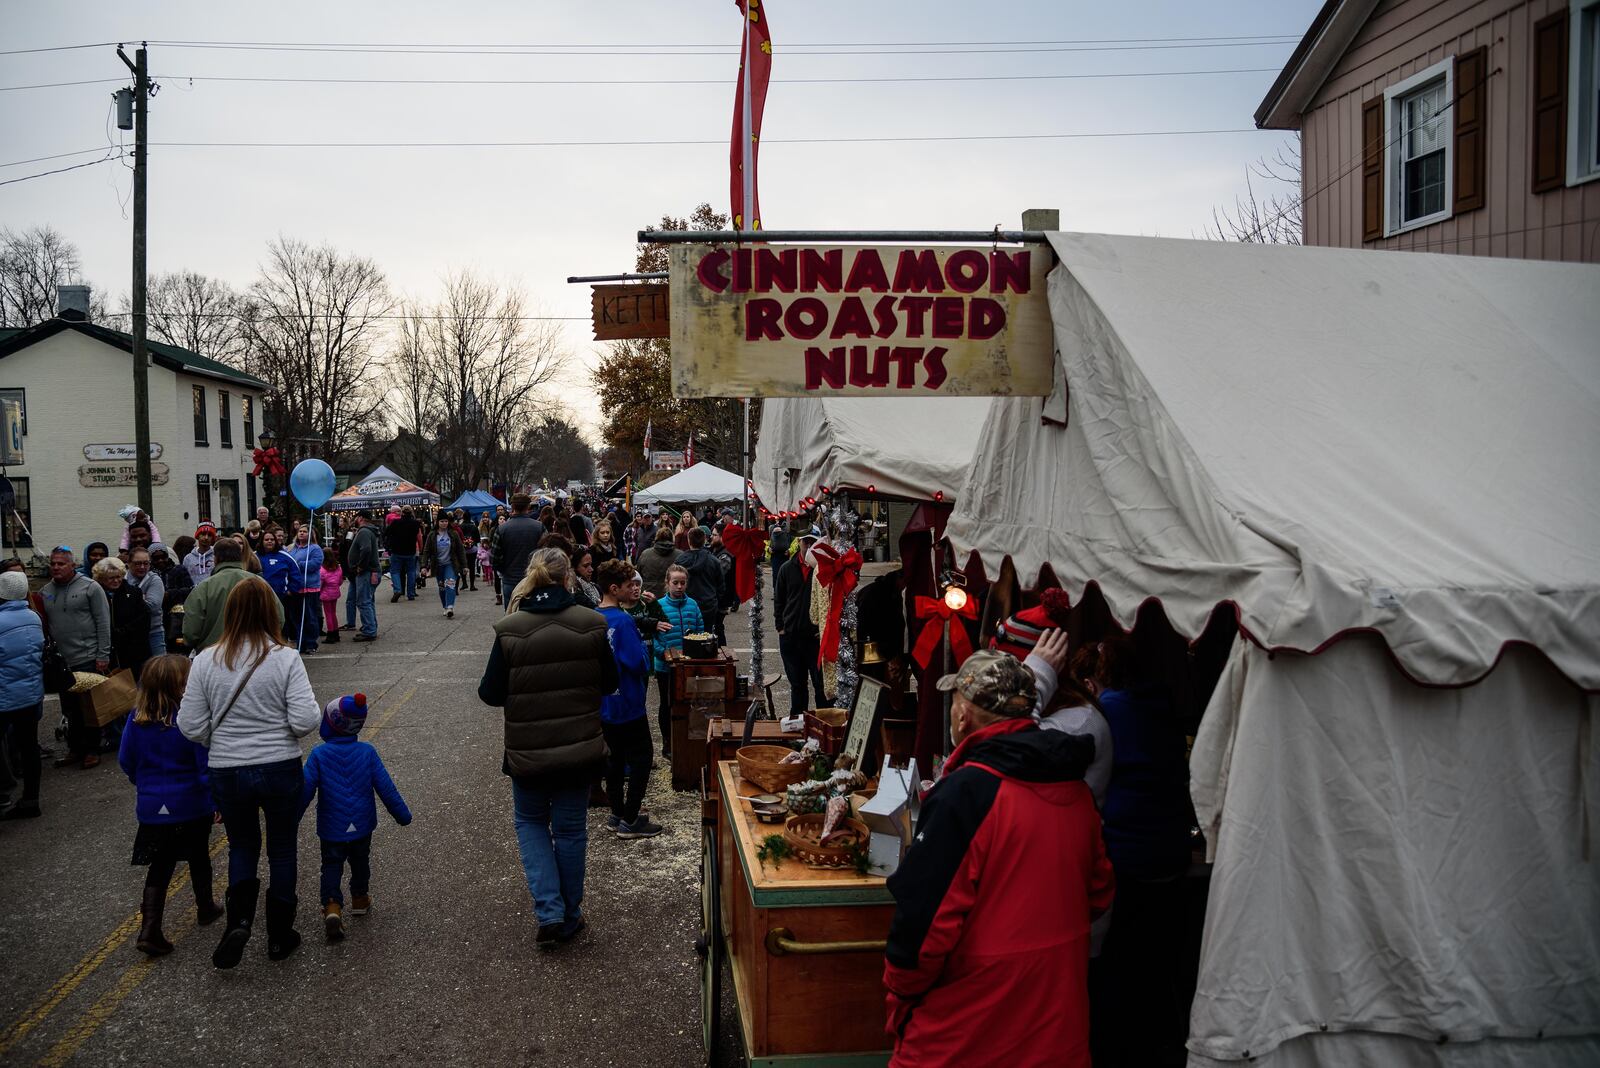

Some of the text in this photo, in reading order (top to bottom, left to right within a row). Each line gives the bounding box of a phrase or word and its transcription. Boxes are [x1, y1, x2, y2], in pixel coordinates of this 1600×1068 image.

[697, 248, 1031, 294] CINNAMON
[745, 295, 1006, 341] ROASTED
[804, 345, 949, 390] NUTS
[105, 447, 115, 455] The
